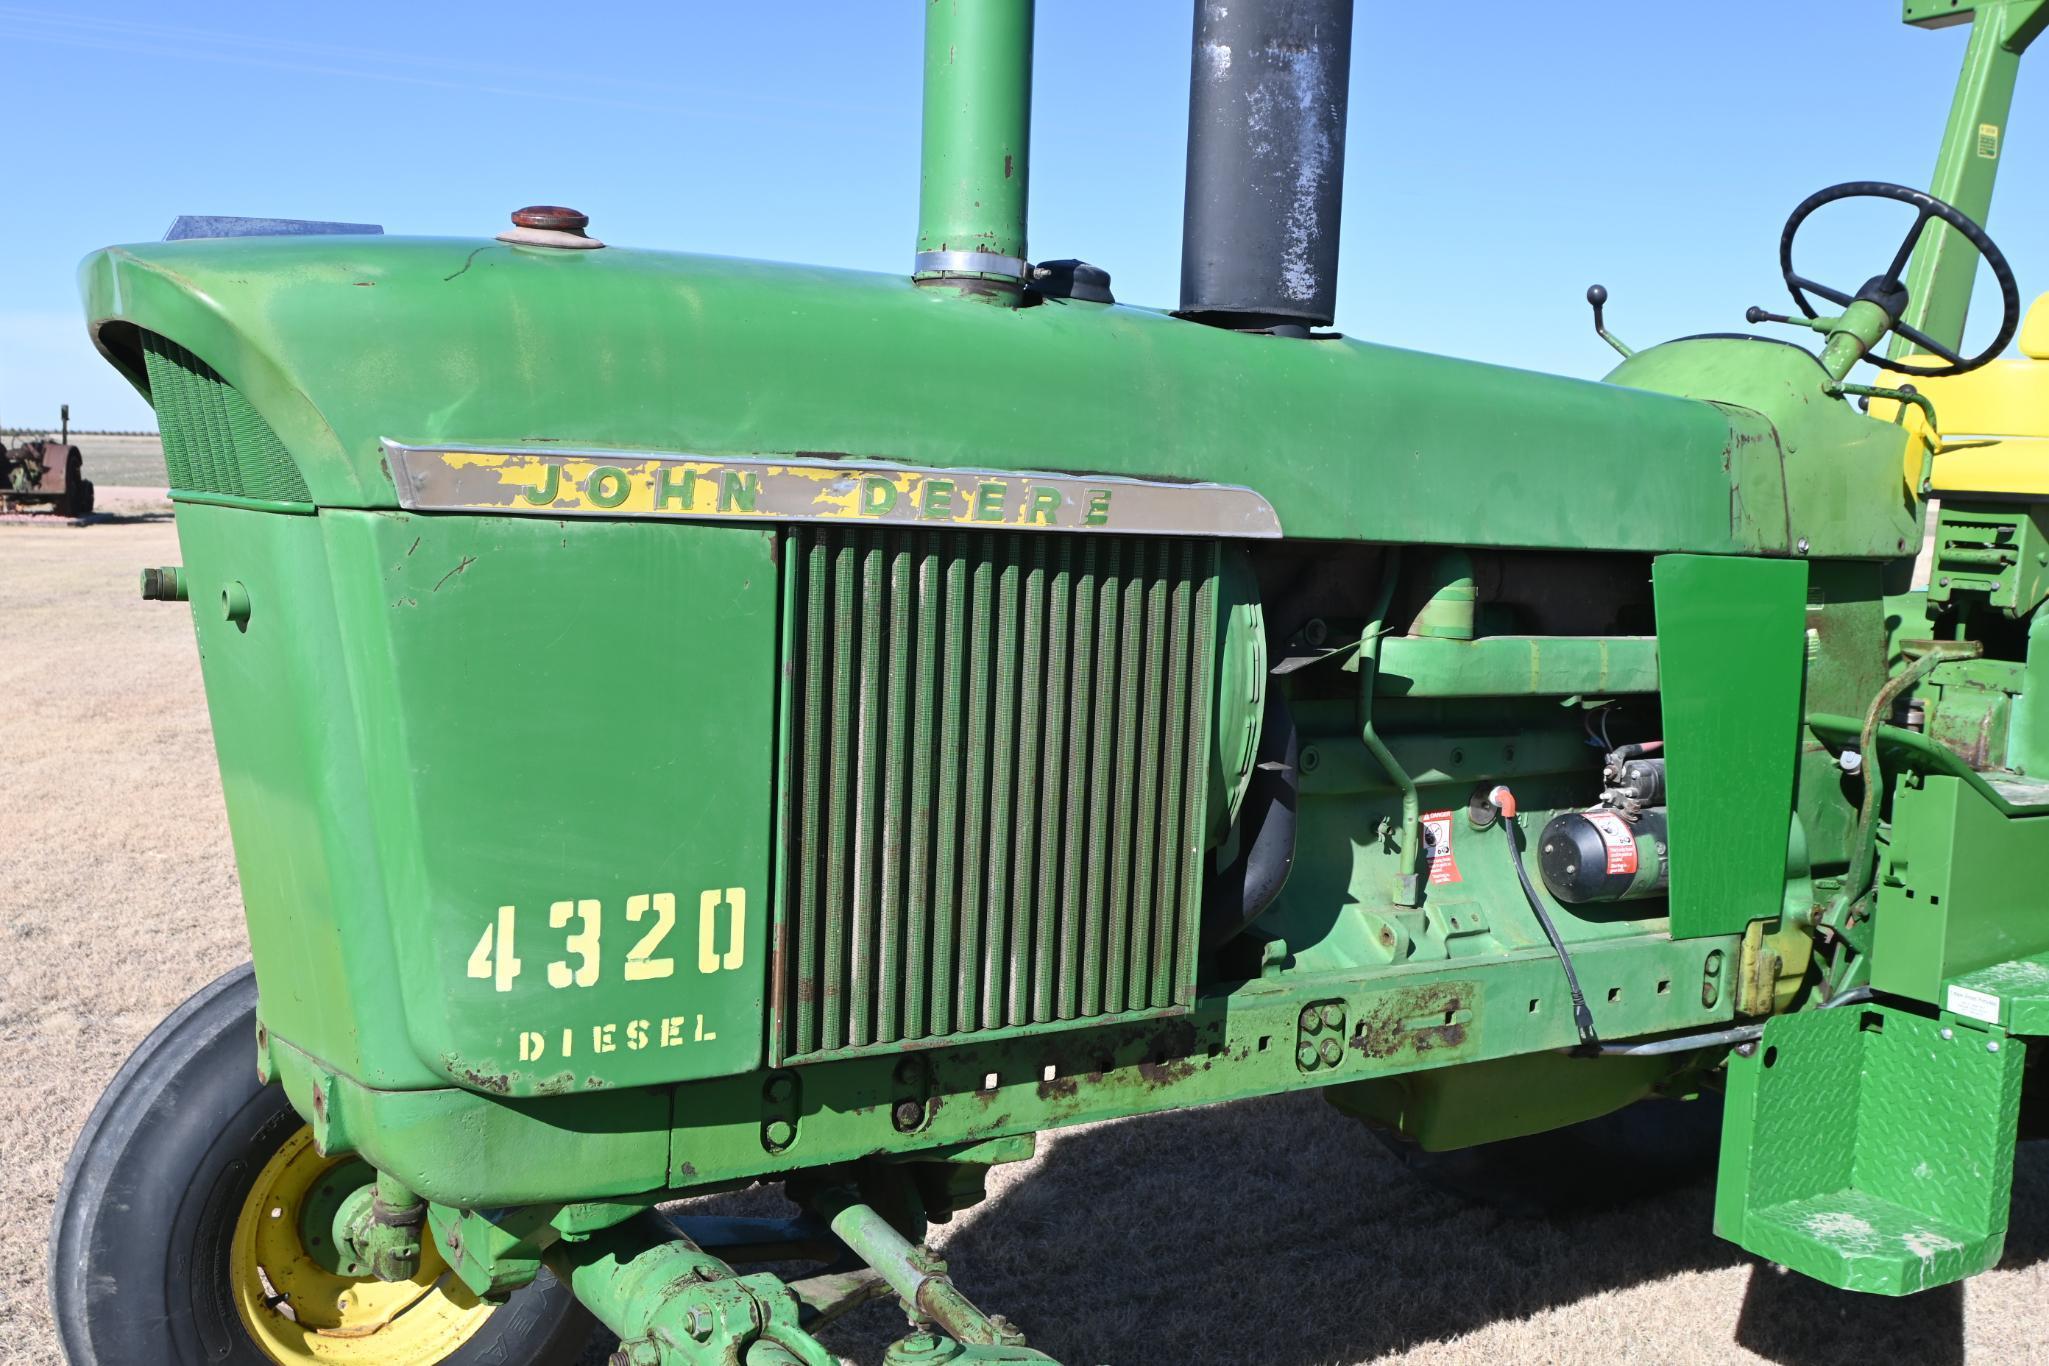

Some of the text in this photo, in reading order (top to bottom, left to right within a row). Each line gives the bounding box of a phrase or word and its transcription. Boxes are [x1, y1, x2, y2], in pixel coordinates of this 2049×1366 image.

[521, 463, 1113, 526] JOHN DEERE
[467, 886, 747, 993] 4320
[518, 1013, 718, 1062] DIESEL
